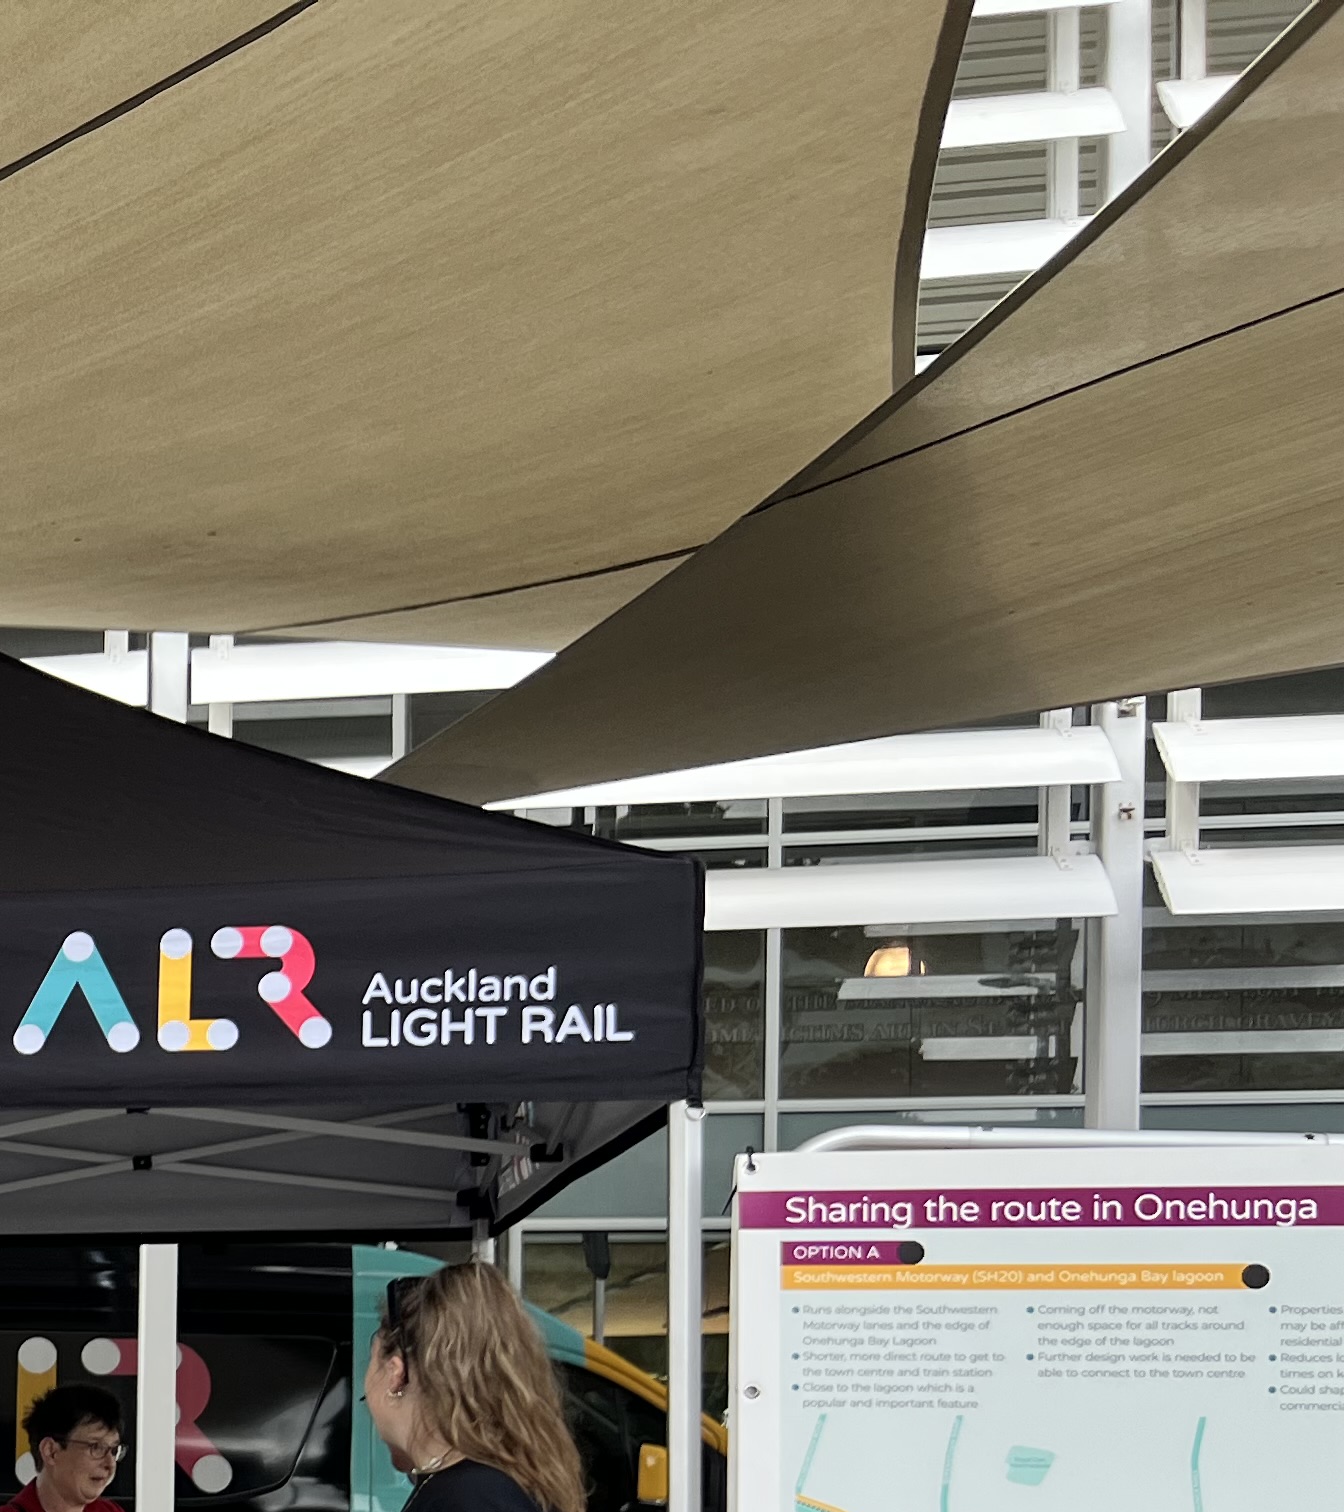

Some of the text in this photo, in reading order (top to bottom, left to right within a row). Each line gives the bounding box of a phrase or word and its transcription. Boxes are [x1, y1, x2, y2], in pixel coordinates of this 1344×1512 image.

[12, 925, 332, 1054] ALR
[361, 966, 557, 1005] Auckland
[361, 1003, 635, 1049] LIGHT RAIL
[785, 1193, 1318, 1229] Sharing the route in Onehunga
[793, 1245, 881, 1260] OPTION A
[793, 1269, 1224, 1287] Southwestern Motorway (SH20) and Onehunga Bay lagoon
[1037, 1304, 1219, 1316] Coming off the motorway, not
[1037, 1319, 1245, 1332] enough space for all tracks around
[1037, 1336, 1058, 1346] the
[1060, 1336, 1092, 1348] edge
[1109, 1336, 1130, 1346] the
[1132, 1336, 1174, 1348] lagoon
[1037, 1351, 1082, 1361] Further
[1084, 1352, 1126, 1364] design
[1128, 1352, 1159, 1362] work
[1174, 1352, 1221, 1362] needed
[1037, 1368, 1062, 1377] able
[1080, 1369, 1130, 1378] connect
[1148, 1368, 1170, 1378] the
[1172, 1369, 1204, 1378] town
[1206, 1369, 1246, 1378] centre
